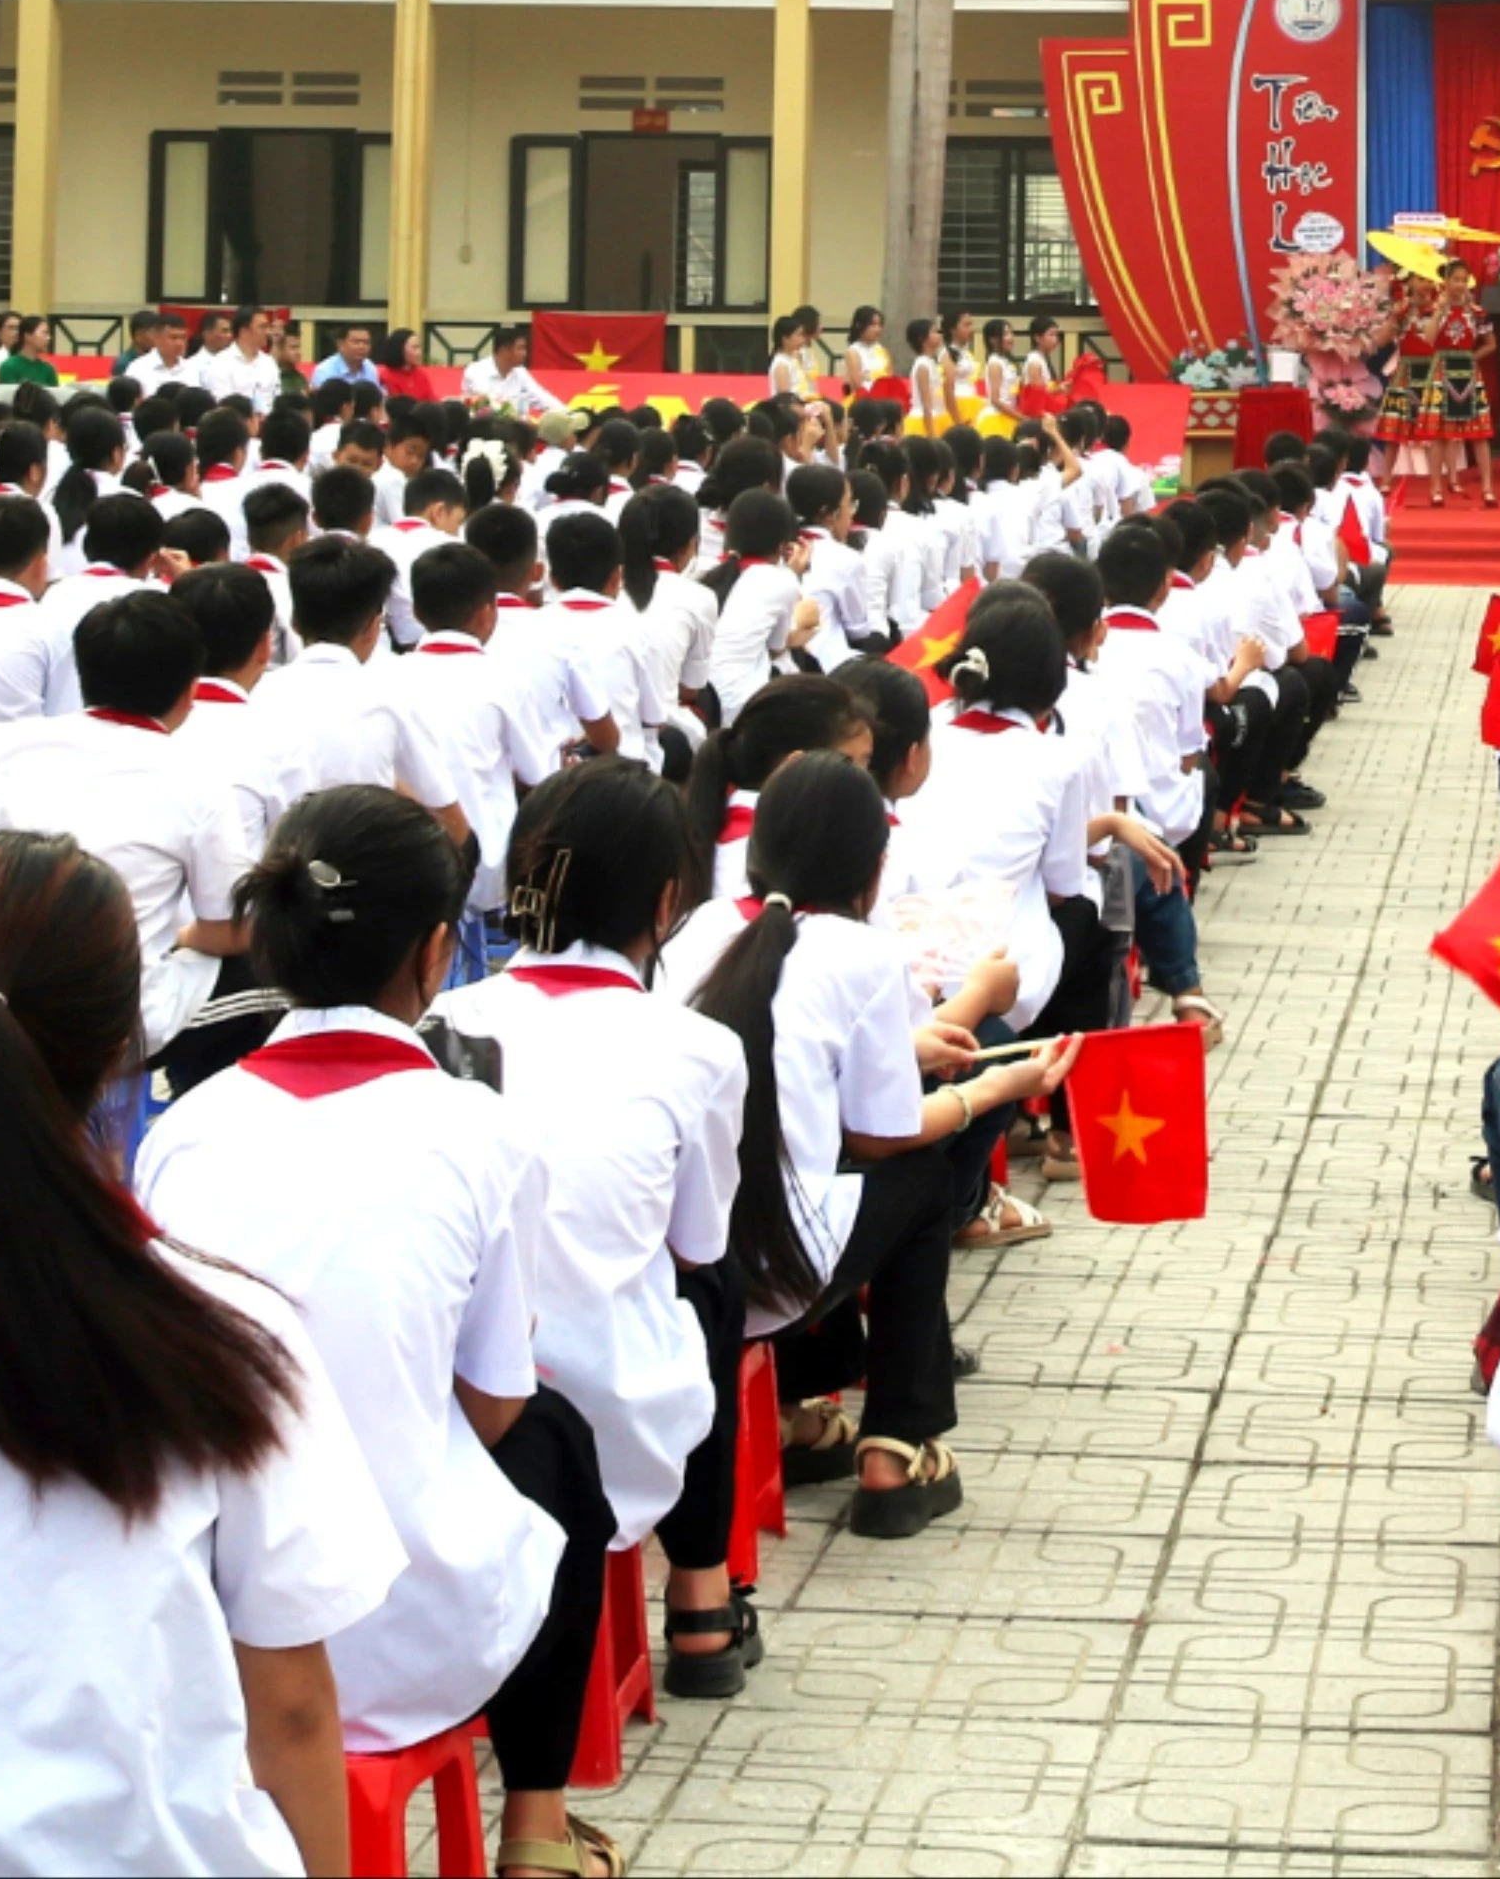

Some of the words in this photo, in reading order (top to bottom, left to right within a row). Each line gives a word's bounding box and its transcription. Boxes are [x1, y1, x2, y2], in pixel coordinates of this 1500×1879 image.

[1251, 73, 1340, 131] Tiên
[1262, 138, 1334, 194] Học
[1271, 202, 1302, 253] L
